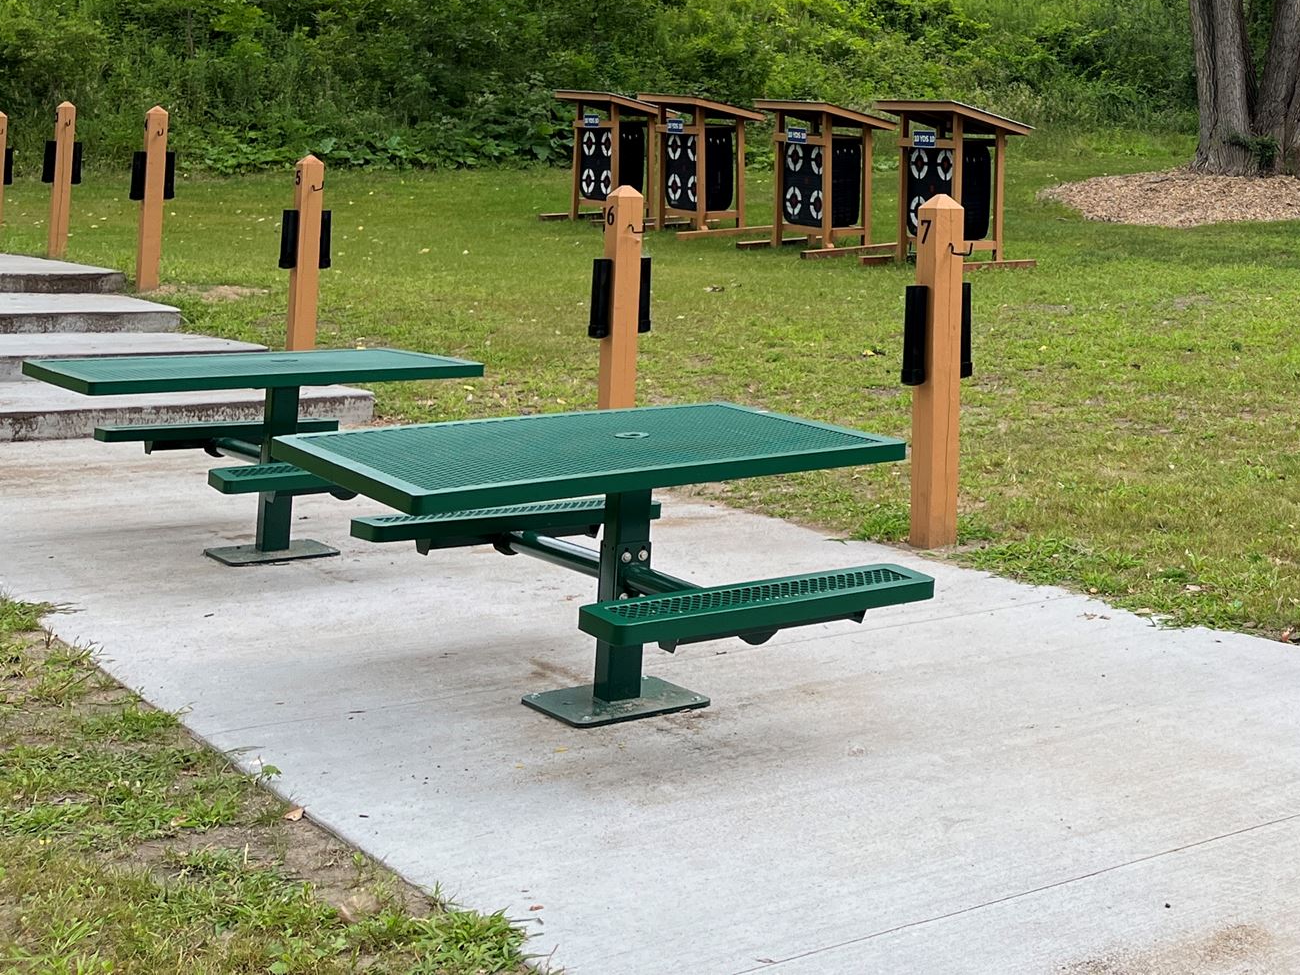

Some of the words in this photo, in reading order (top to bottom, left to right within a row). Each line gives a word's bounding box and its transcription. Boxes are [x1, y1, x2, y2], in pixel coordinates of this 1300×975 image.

[295, 169, 301, 186] 5
[607, 205, 614, 226] 6
[921, 219, 932, 244] 7
